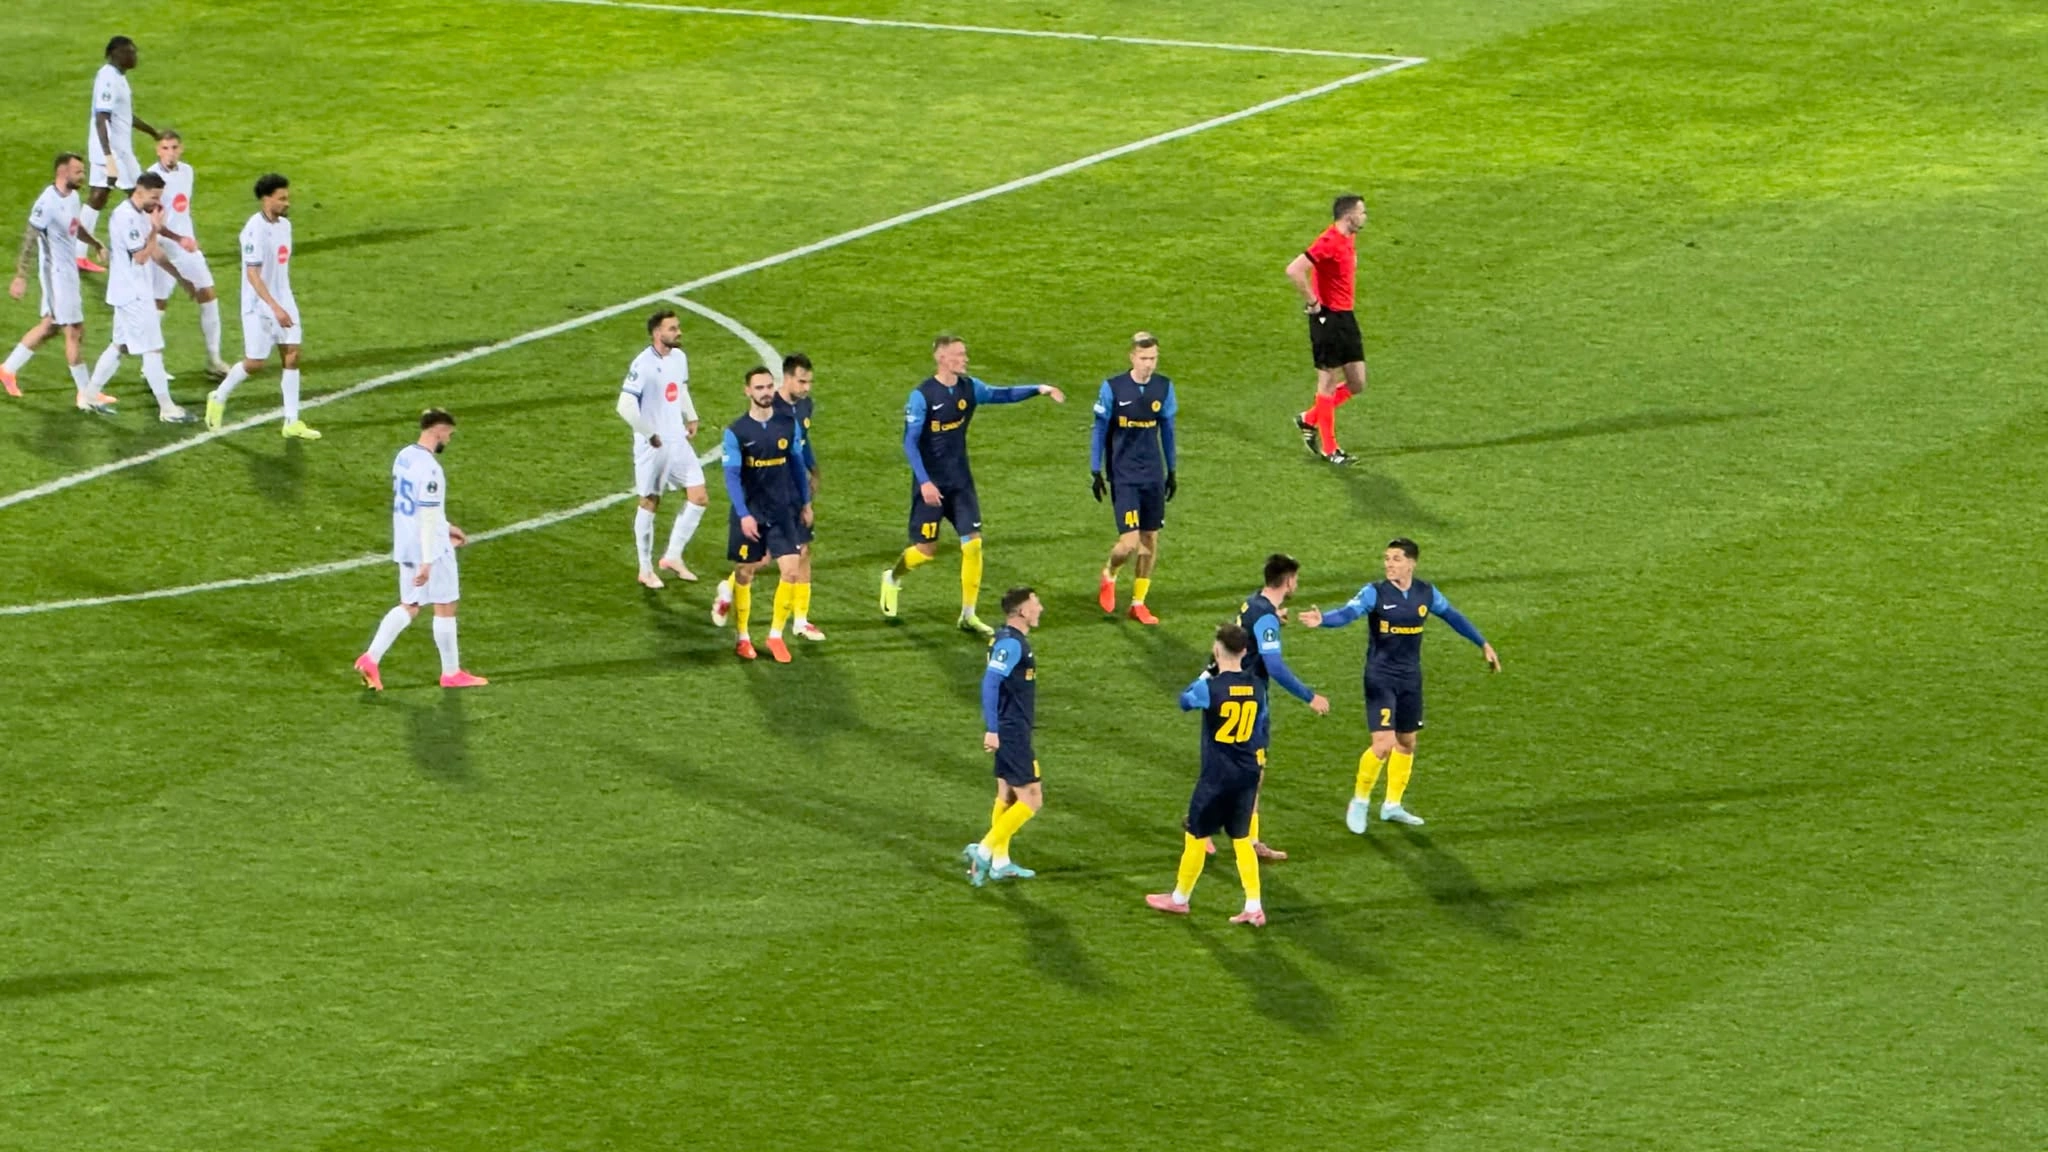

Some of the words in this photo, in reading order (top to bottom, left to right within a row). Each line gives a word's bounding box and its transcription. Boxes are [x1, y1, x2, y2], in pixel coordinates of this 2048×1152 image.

[393, 477, 416, 516] 5
[1215, 700, 1258, 744] 20
[1381, 708, 1391, 727] 2
